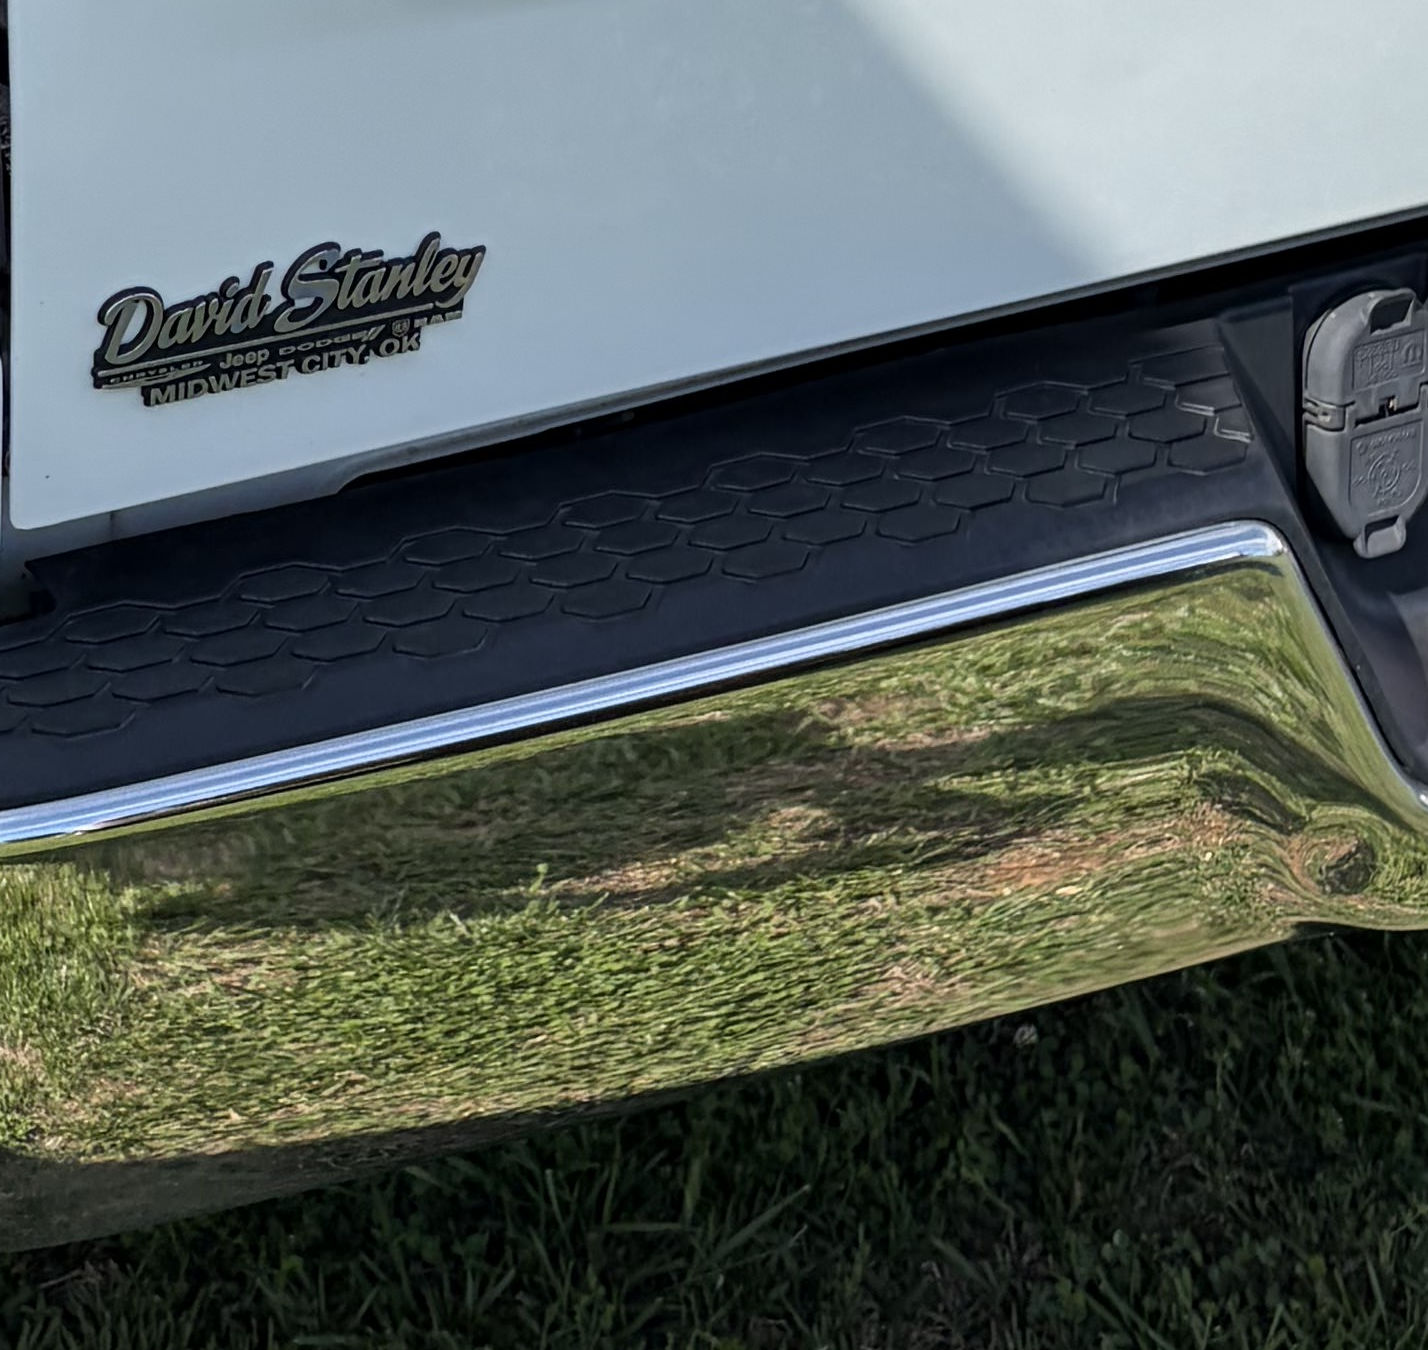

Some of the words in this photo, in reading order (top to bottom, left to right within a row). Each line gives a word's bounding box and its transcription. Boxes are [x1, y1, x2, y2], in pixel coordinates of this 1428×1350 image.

[101, 261, 274, 364] David
[274, 232, 485, 333] Stanley
[149, 362, 294, 406] MIDWEST
[380, 332, 421, 358] OK
[219, 347, 270, 370] Jeep
